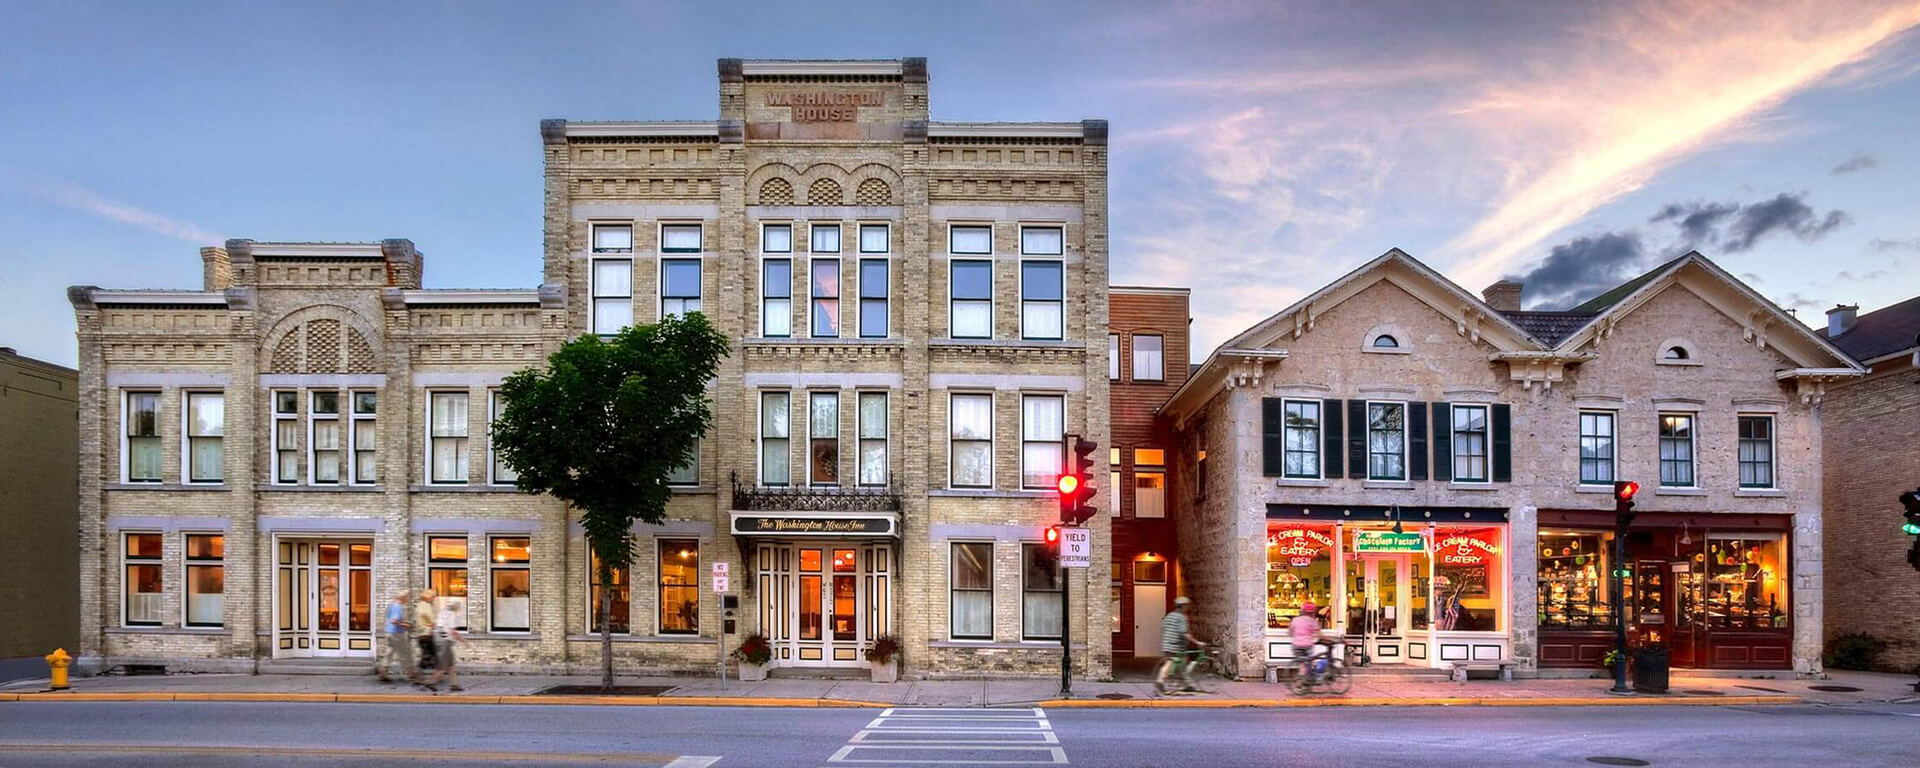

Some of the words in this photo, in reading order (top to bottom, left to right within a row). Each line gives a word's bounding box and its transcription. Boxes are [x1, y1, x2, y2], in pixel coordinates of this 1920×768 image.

[767, 91, 884, 107] WASHINGTON
[794, 106, 853, 121] HOUSE
[757, 518, 774, 529] The
[774, 518, 822, 532] Washington
[823, 520, 850, 531] House
[849, 520, 866, 531] Inn
[1065, 533, 1086, 542] YIELD
[1306, 530, 1334, 548] PARLOR
[1071, 544, 1080, 552] TO
[1280, 546, 1320, 556] EATERY
[1290, 557, 1311, 565] OPEN
[1444, 555, 1482, 563] EATERY
